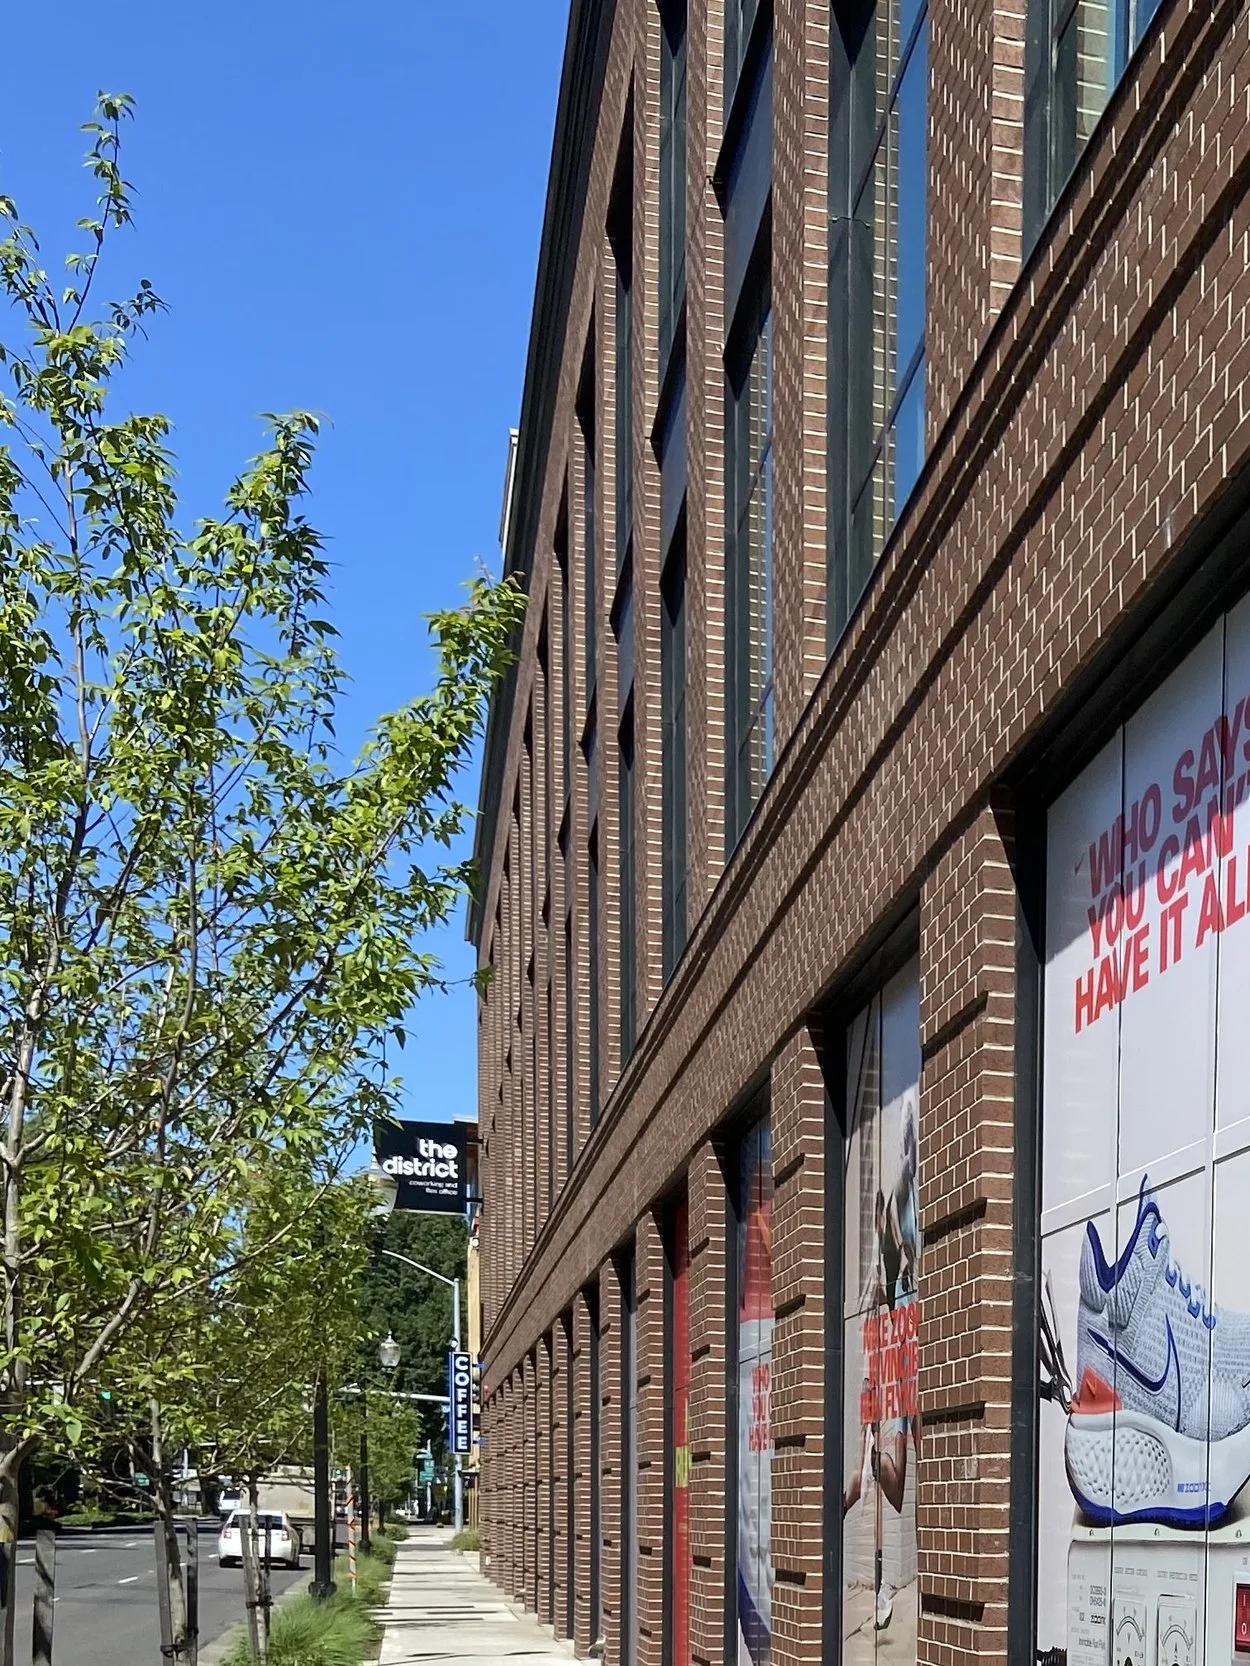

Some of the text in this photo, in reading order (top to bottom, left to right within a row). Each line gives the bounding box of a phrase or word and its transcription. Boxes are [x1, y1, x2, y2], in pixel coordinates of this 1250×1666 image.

[1089, 783, 1162, 898] WHO
[1087, 861, 1146, 960] YOU
[1075, 923, 1150, 1034] HAVE
[1160, 892, 1188, 974] IT
[382, 1156, 459, 1178] district
[419, 1138, 458, 1159] the
[891, 1302, 919, 1343] ZOO
[455, 1356, 470, 1450] COFFEE
